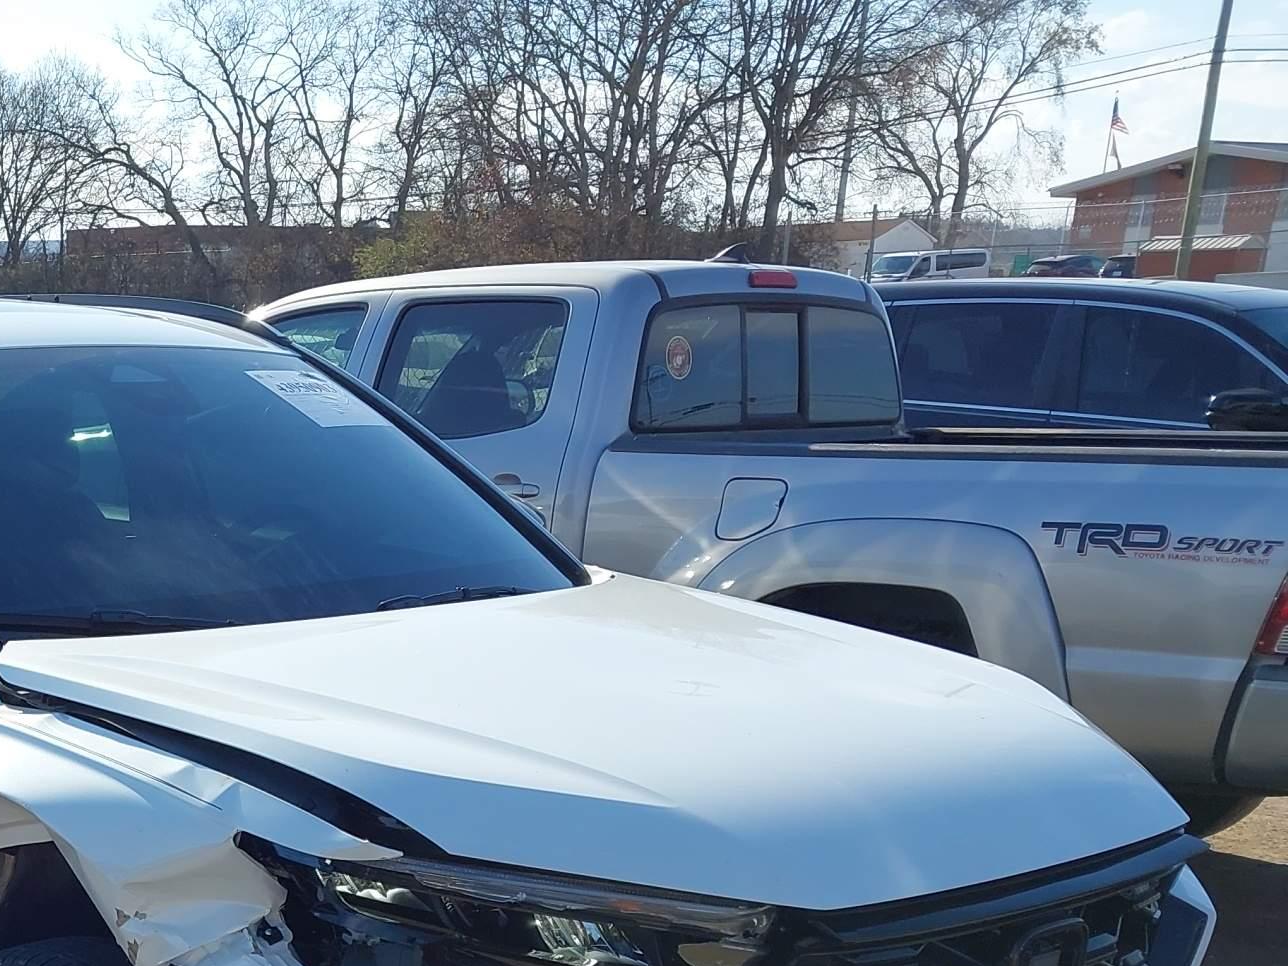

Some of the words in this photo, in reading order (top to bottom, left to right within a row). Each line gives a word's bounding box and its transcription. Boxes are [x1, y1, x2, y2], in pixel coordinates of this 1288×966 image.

[1041, 521, 1171, 557] TRD
[1173, 536, 1286, 555] SPORT
[1133, 551, 1166, 560] TOYOTA
[1168, 553, 1201, 562] RACING
